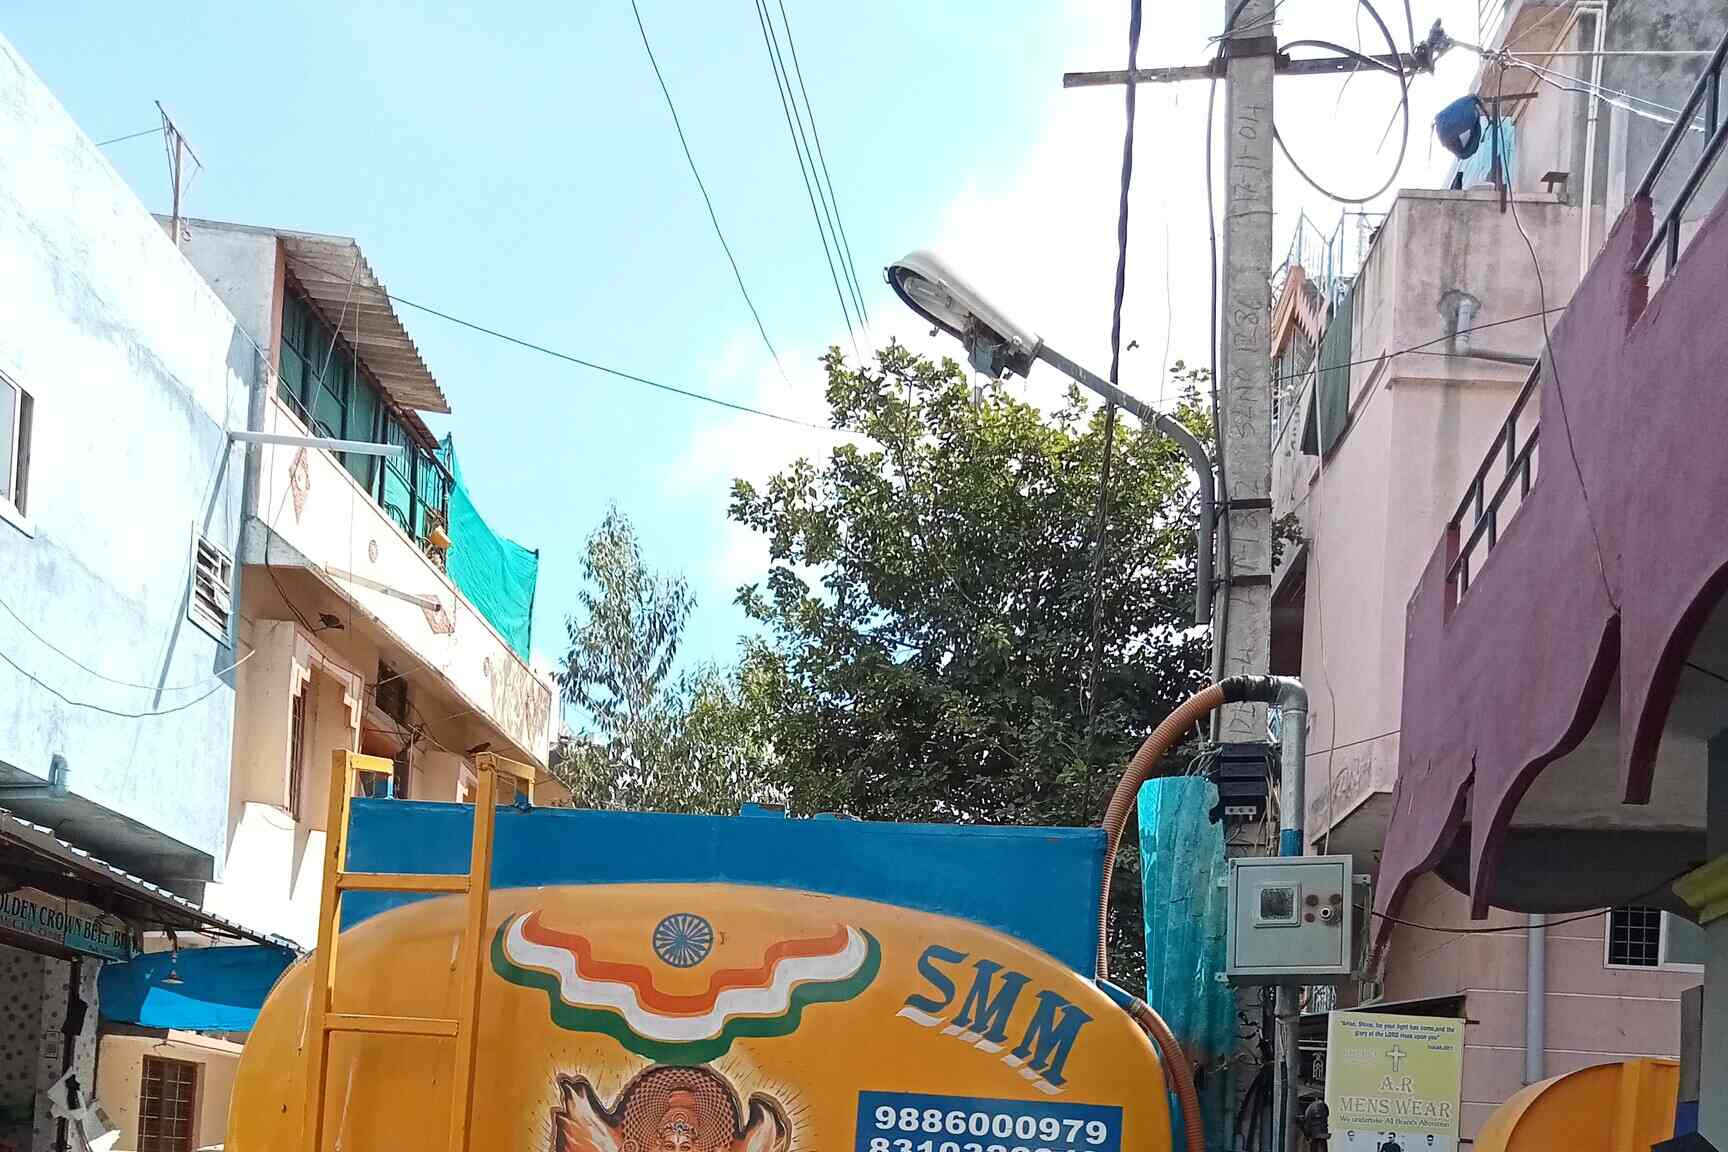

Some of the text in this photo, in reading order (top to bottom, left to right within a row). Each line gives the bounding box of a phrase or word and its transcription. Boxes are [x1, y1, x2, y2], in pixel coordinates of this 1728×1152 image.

[902, 944, 1095, 1090] SMM
[875, 1106, 1107, 1144] 9886000979
[1340, 1097, 1451, 1118] MENS WEAR
